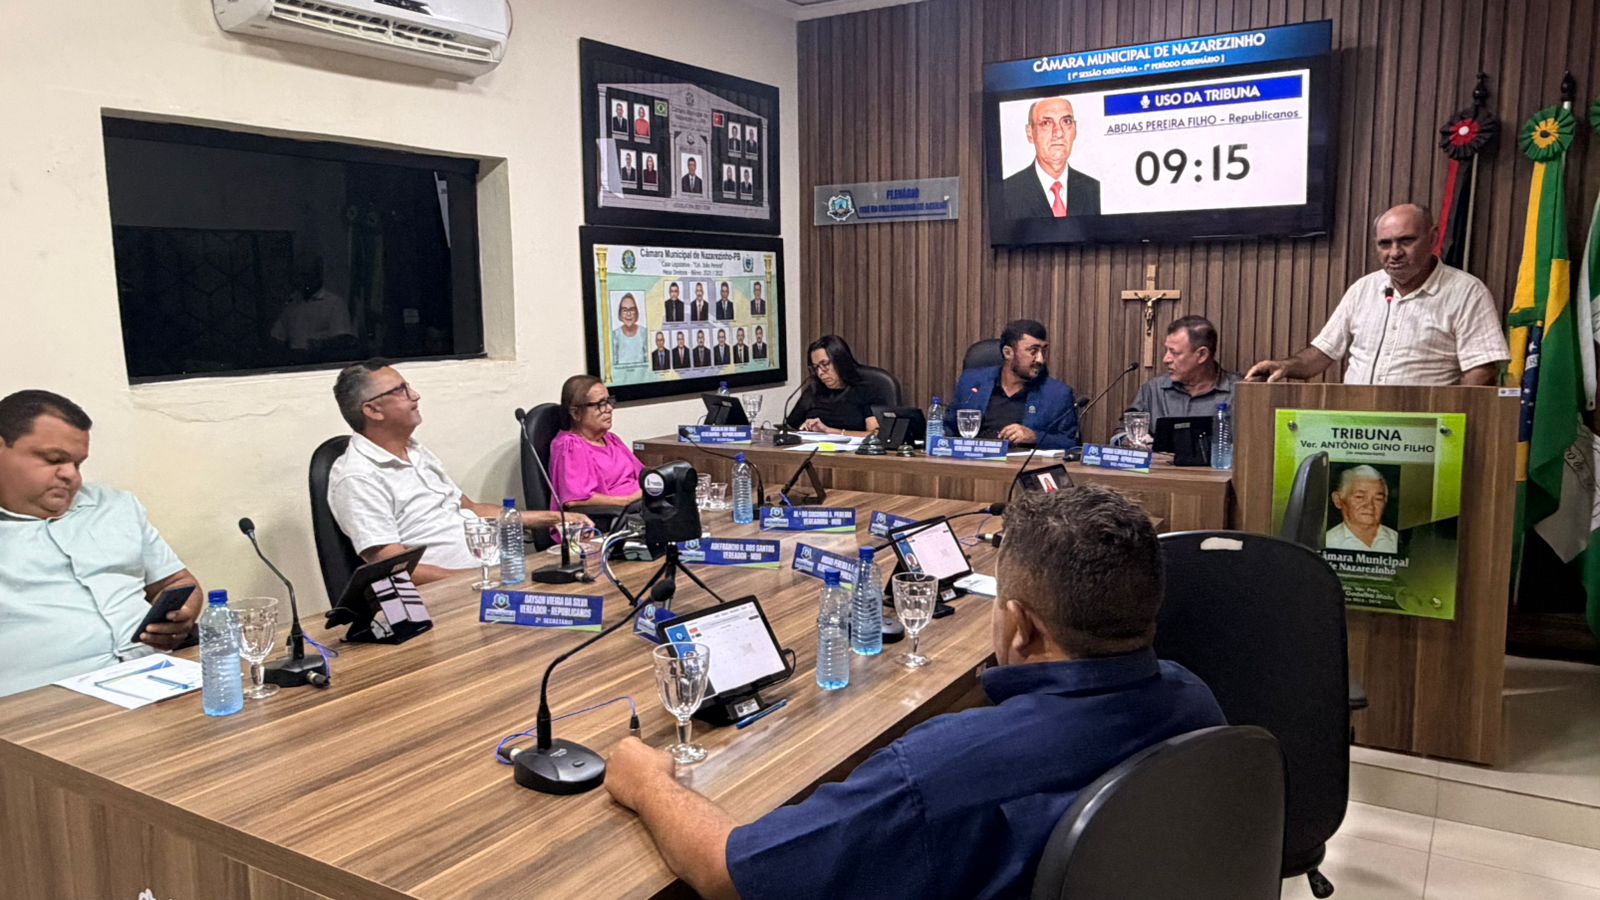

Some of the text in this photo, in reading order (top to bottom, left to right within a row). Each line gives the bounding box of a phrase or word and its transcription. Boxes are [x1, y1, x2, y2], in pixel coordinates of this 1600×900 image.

[1033, 32, 1266, 73] CÂMARA MUNICIPAL DE NAZAREZINHO
[1079, 68, 1101, 78] SESSÃO
[1102, 65, 1138, 76] ORDINÁRIA
[1181, 55, 1220, 66] ORDINÁRIO
[1155, 85, 1261, 107] USO DA TRIBUNA
[1107, 122, 1143, 134] ABDIAS
[1145, 118, 1185, 131] PEREIRA
[1188, 115, 1217, 126] FILHO
[1229, 109, 1299, 124] Republicanos
[1135, 143, 1250, 186] 09:15
[640, 248, 664, 258] Câmara
[664, 249, 692, 260] Municipal
[693, 251, 700, 259] de
[1331, 427, 1402, 441] TRIBUNA
[1300, 440, 1435, 453] Ver. ANTÔNIO GINO FILHO
[756, 544, 775, 553] SANTOS
[1317, 550, 1410, 568] âmara Municipal
[1340, 563, 1397, 575] Nazarezinho
[573, 597, 588, 608] SILVA
[520, 604, 547, 615] VEREADOR
[551, 606, 592, 618] REPUBLICANOS
